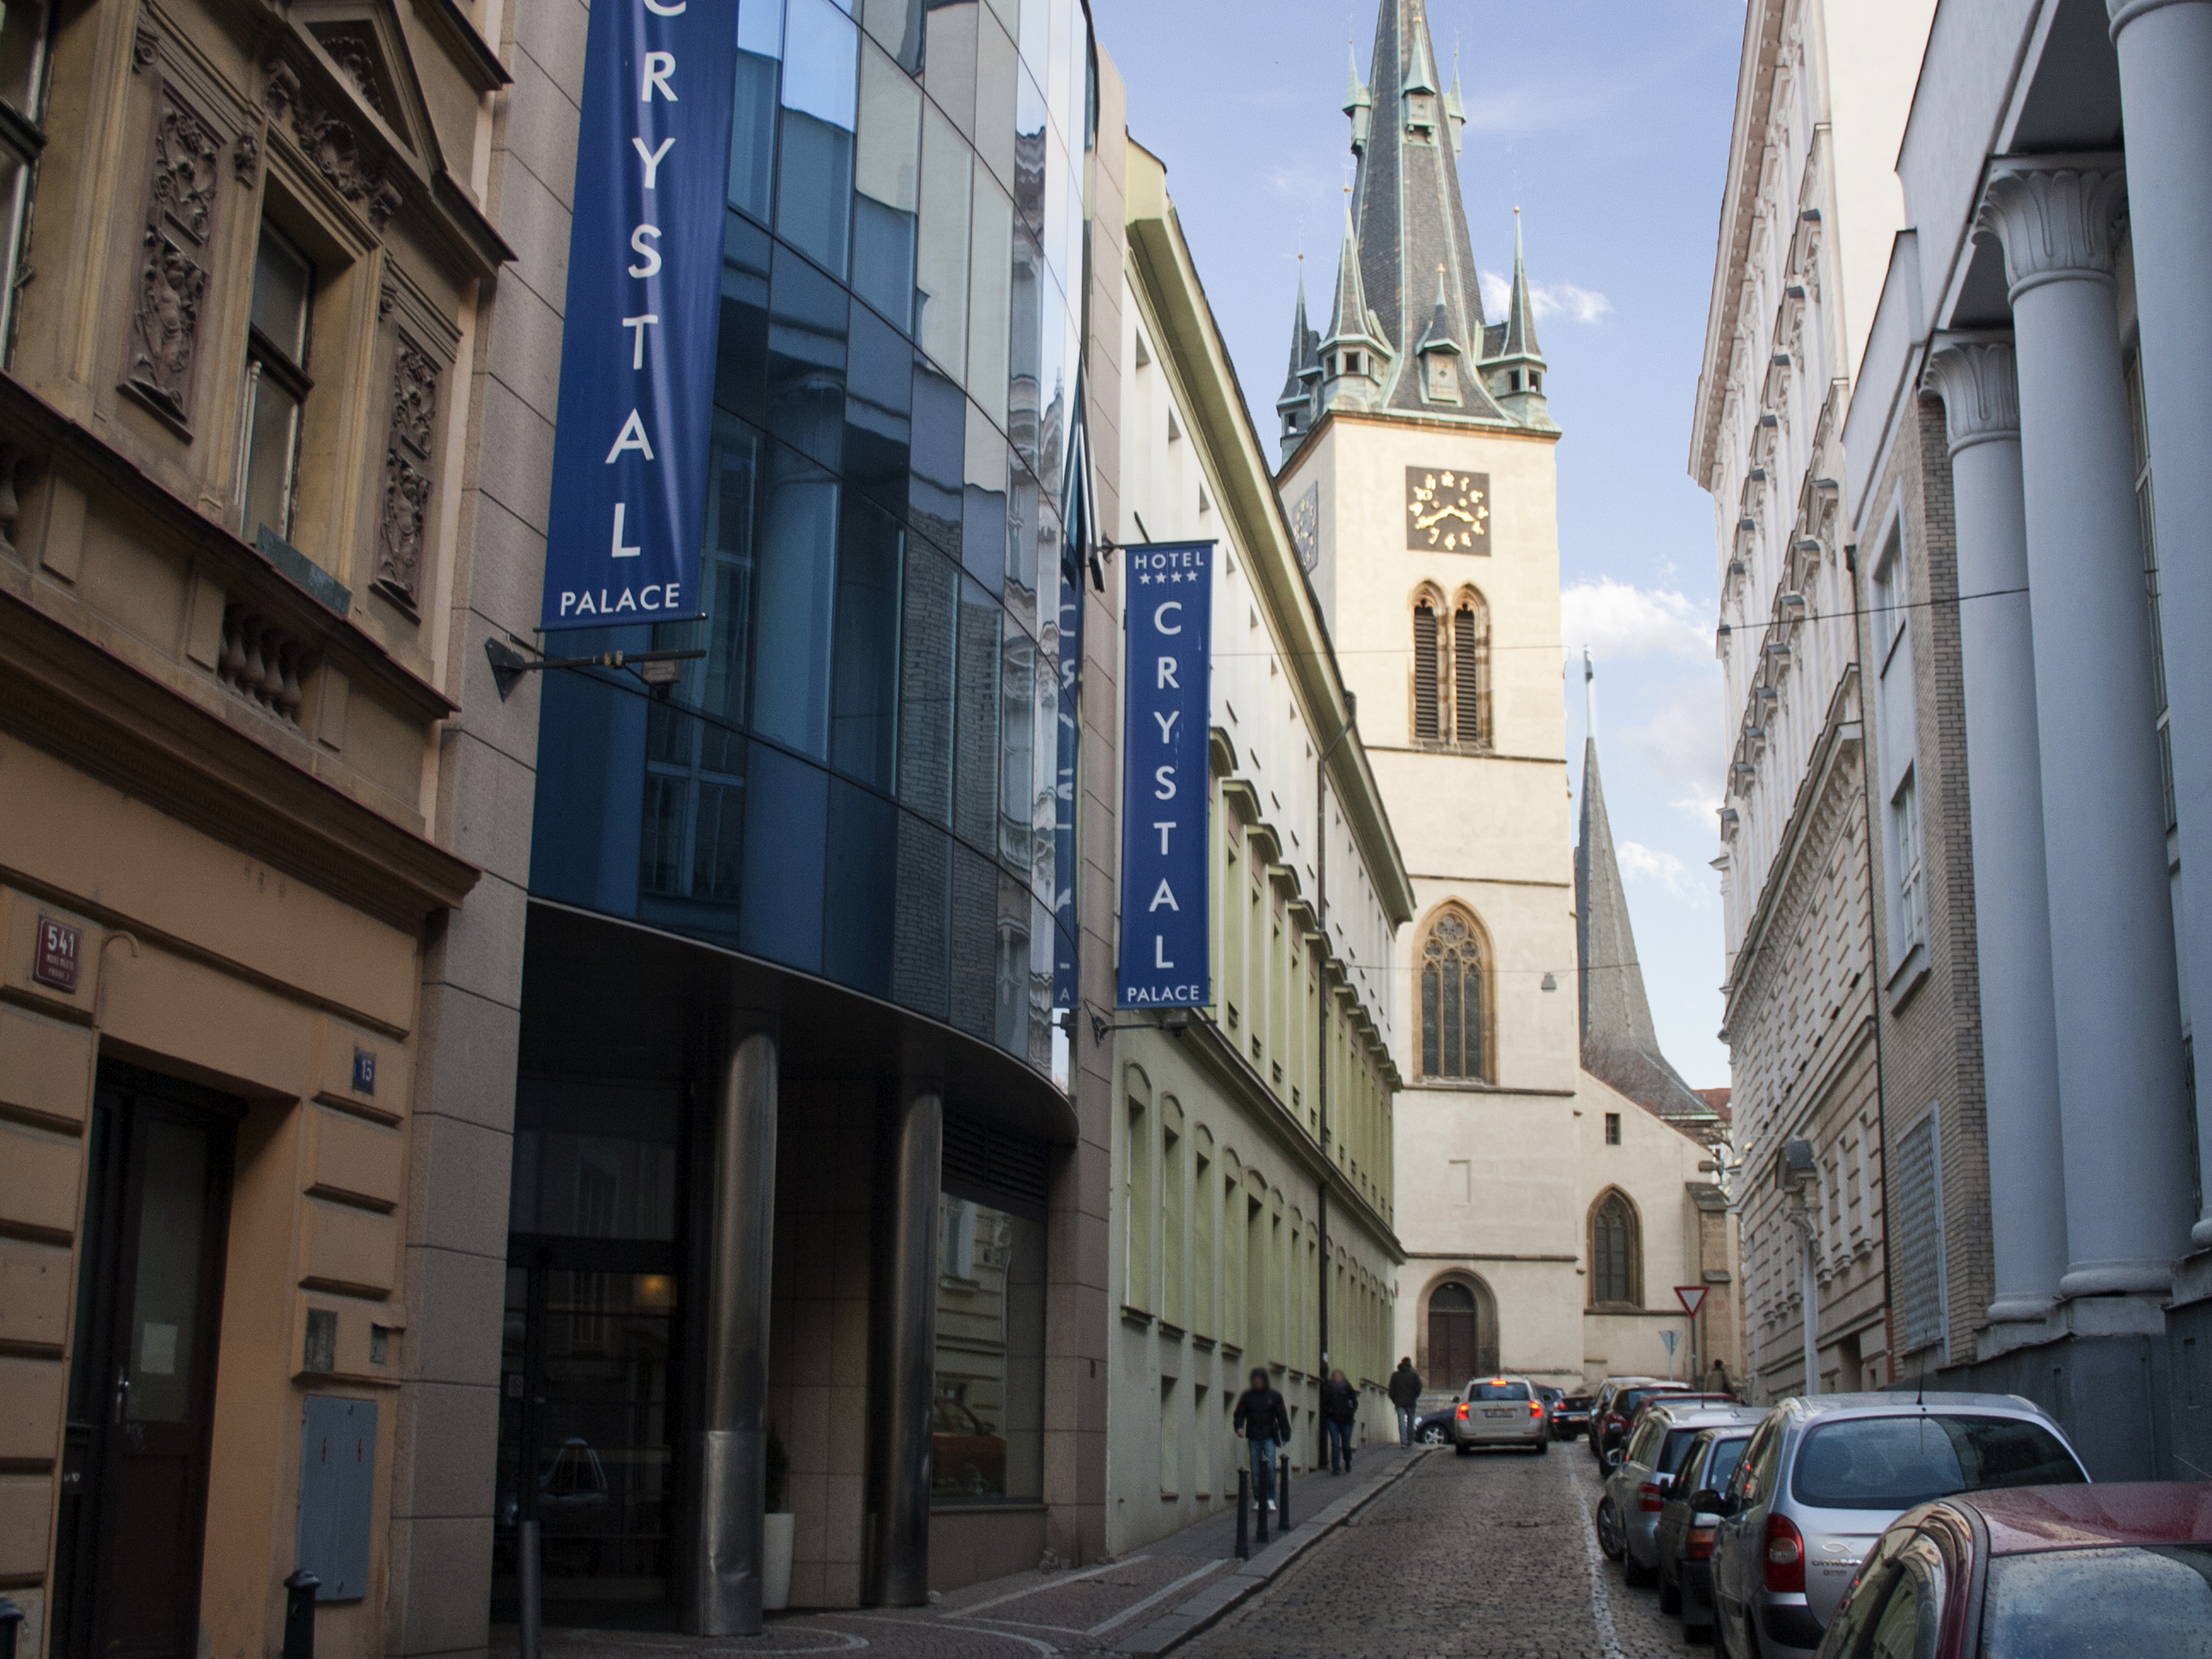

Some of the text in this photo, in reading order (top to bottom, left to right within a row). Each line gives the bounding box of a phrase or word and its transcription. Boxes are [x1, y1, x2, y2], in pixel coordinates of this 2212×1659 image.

[1134, 551, 1204, 569] HOTEL
[559, 583, 680, 617] PALACE
[1149, 601, 1182, 969] CRYSTAL
[47, 925, 75, 958] 541
[1128, 985, 1200, 1002] PALACE
[362, 1059, 373, 1082] 15
